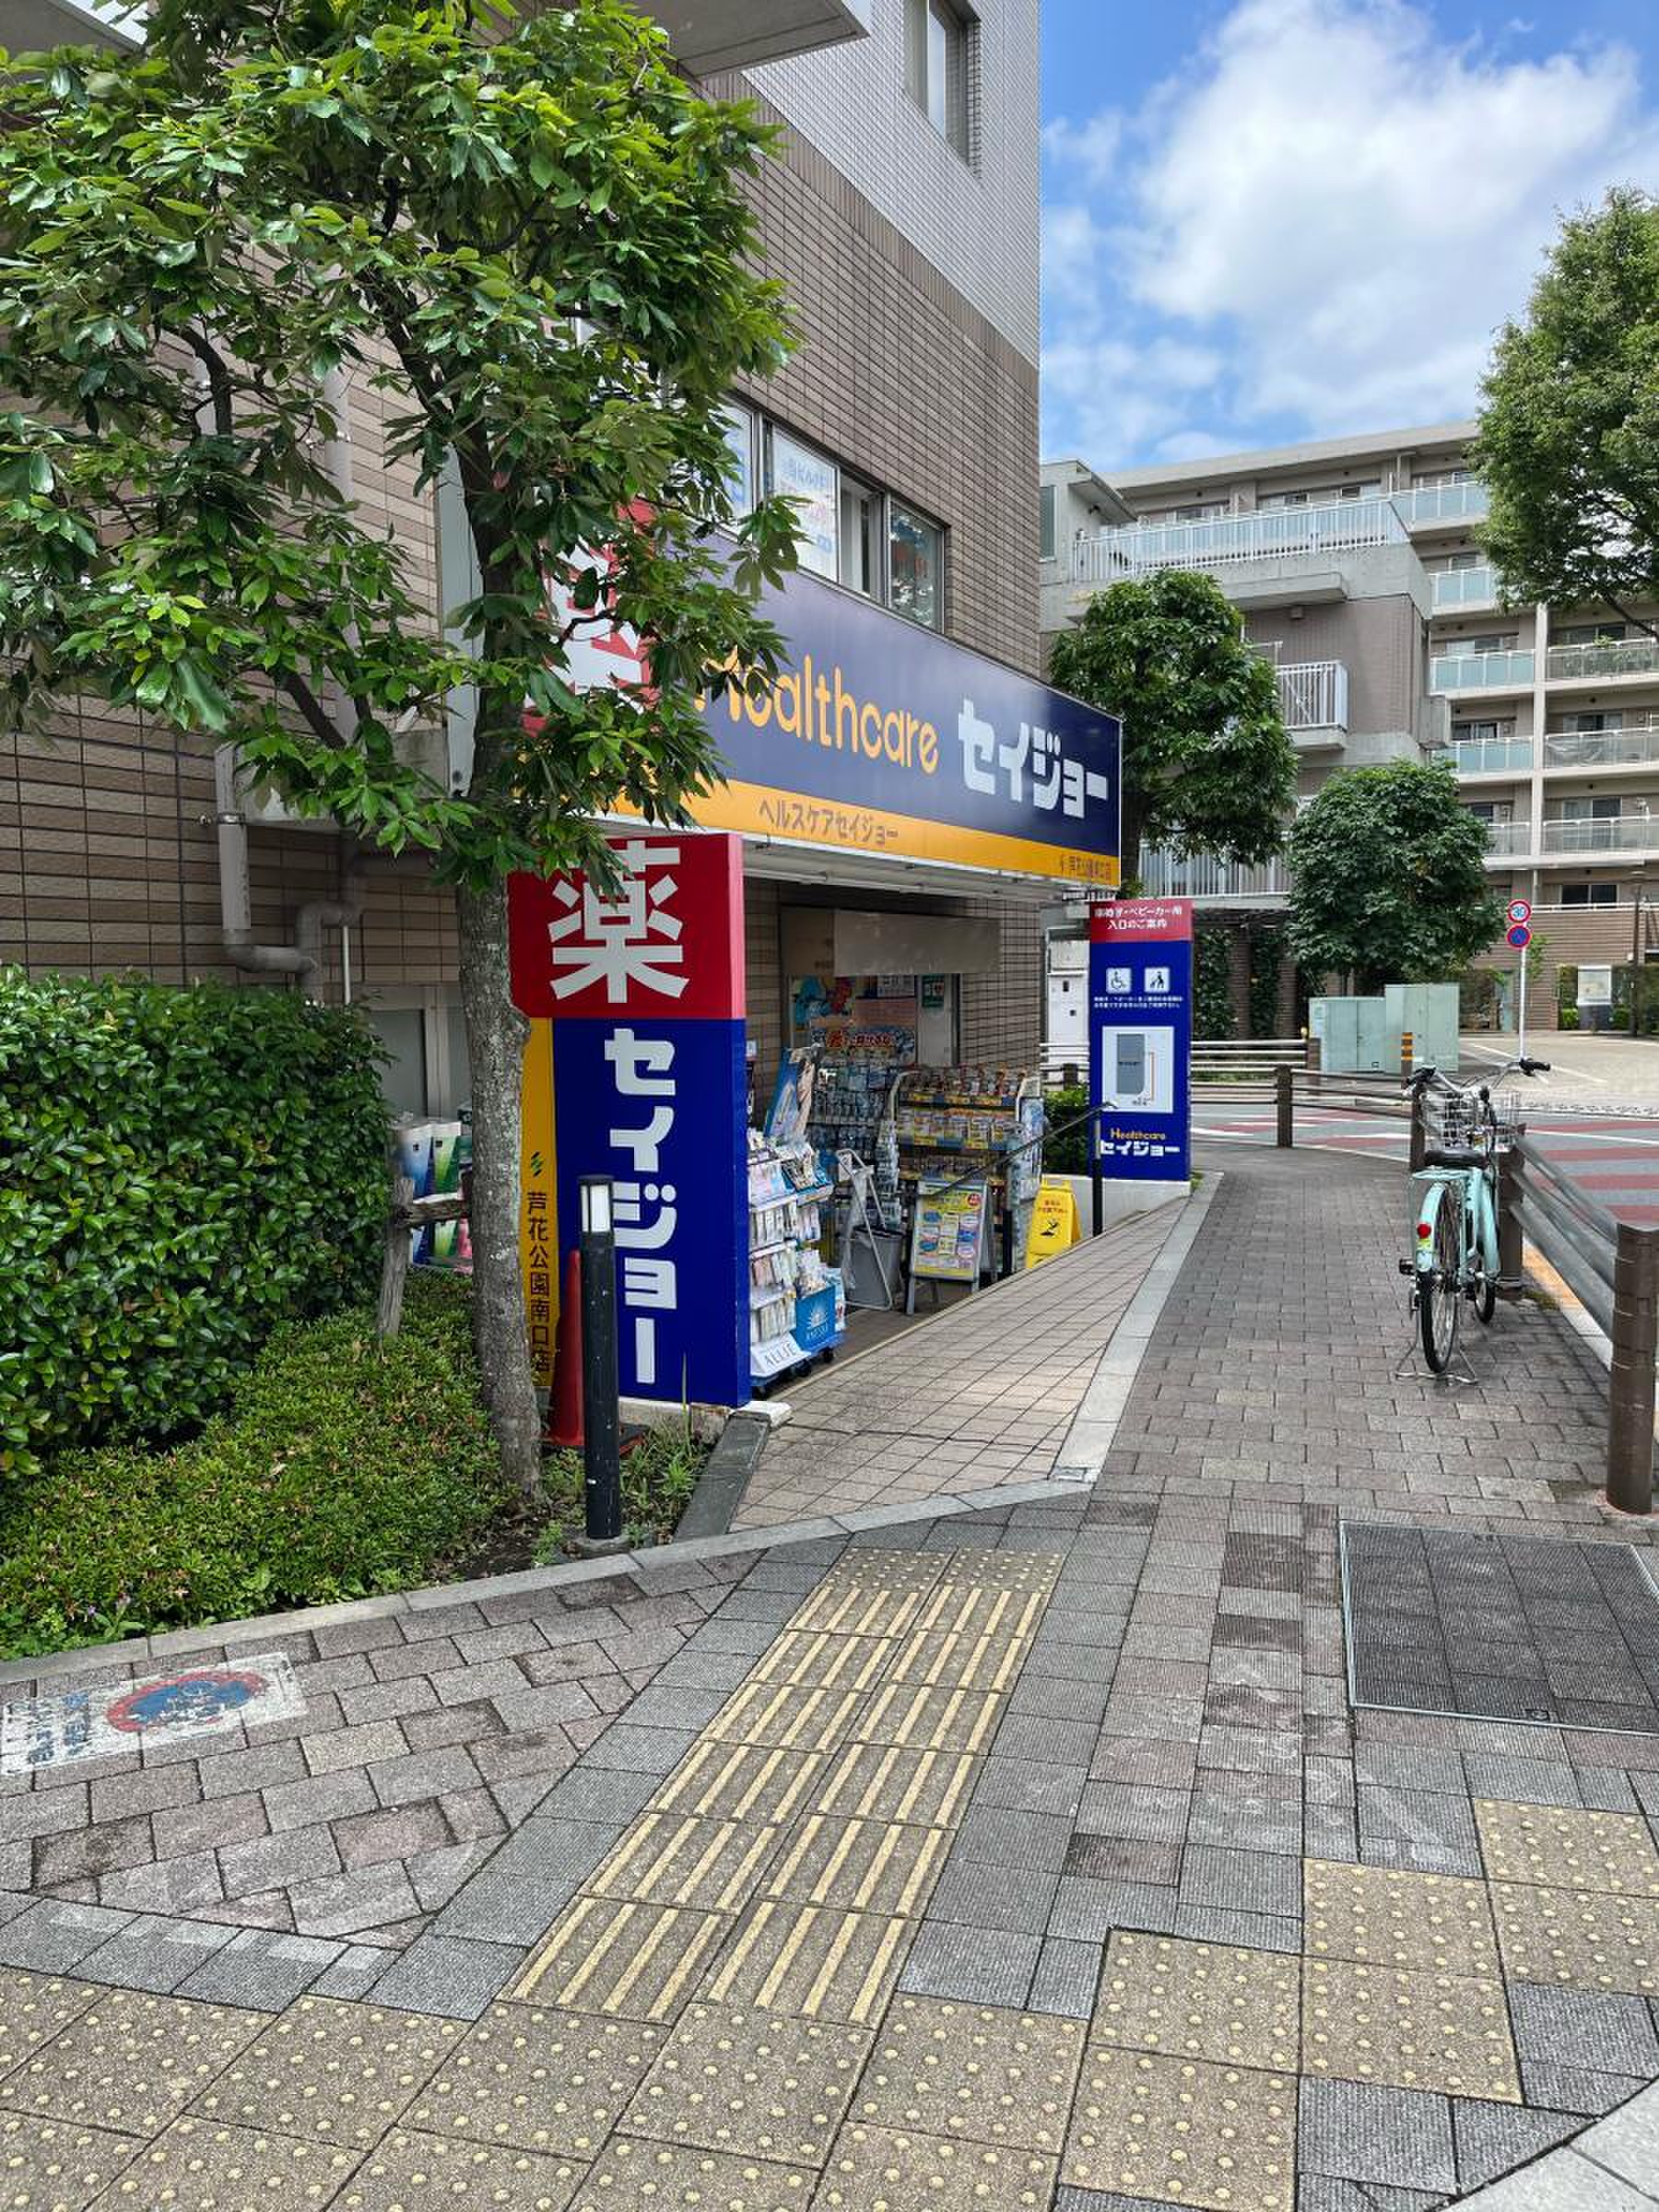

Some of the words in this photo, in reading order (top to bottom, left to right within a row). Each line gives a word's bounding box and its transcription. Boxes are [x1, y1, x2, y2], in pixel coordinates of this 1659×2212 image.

[958, 697, 1107, 818] セイジョー
[758, 798, 900, 847] ヘルスケアセイジョー
[547, 840, 689, 1003] 薬
[605, 1029, 677, 1383] セイジョー
[1100, 1140, 1181, 1157] セイジョー
